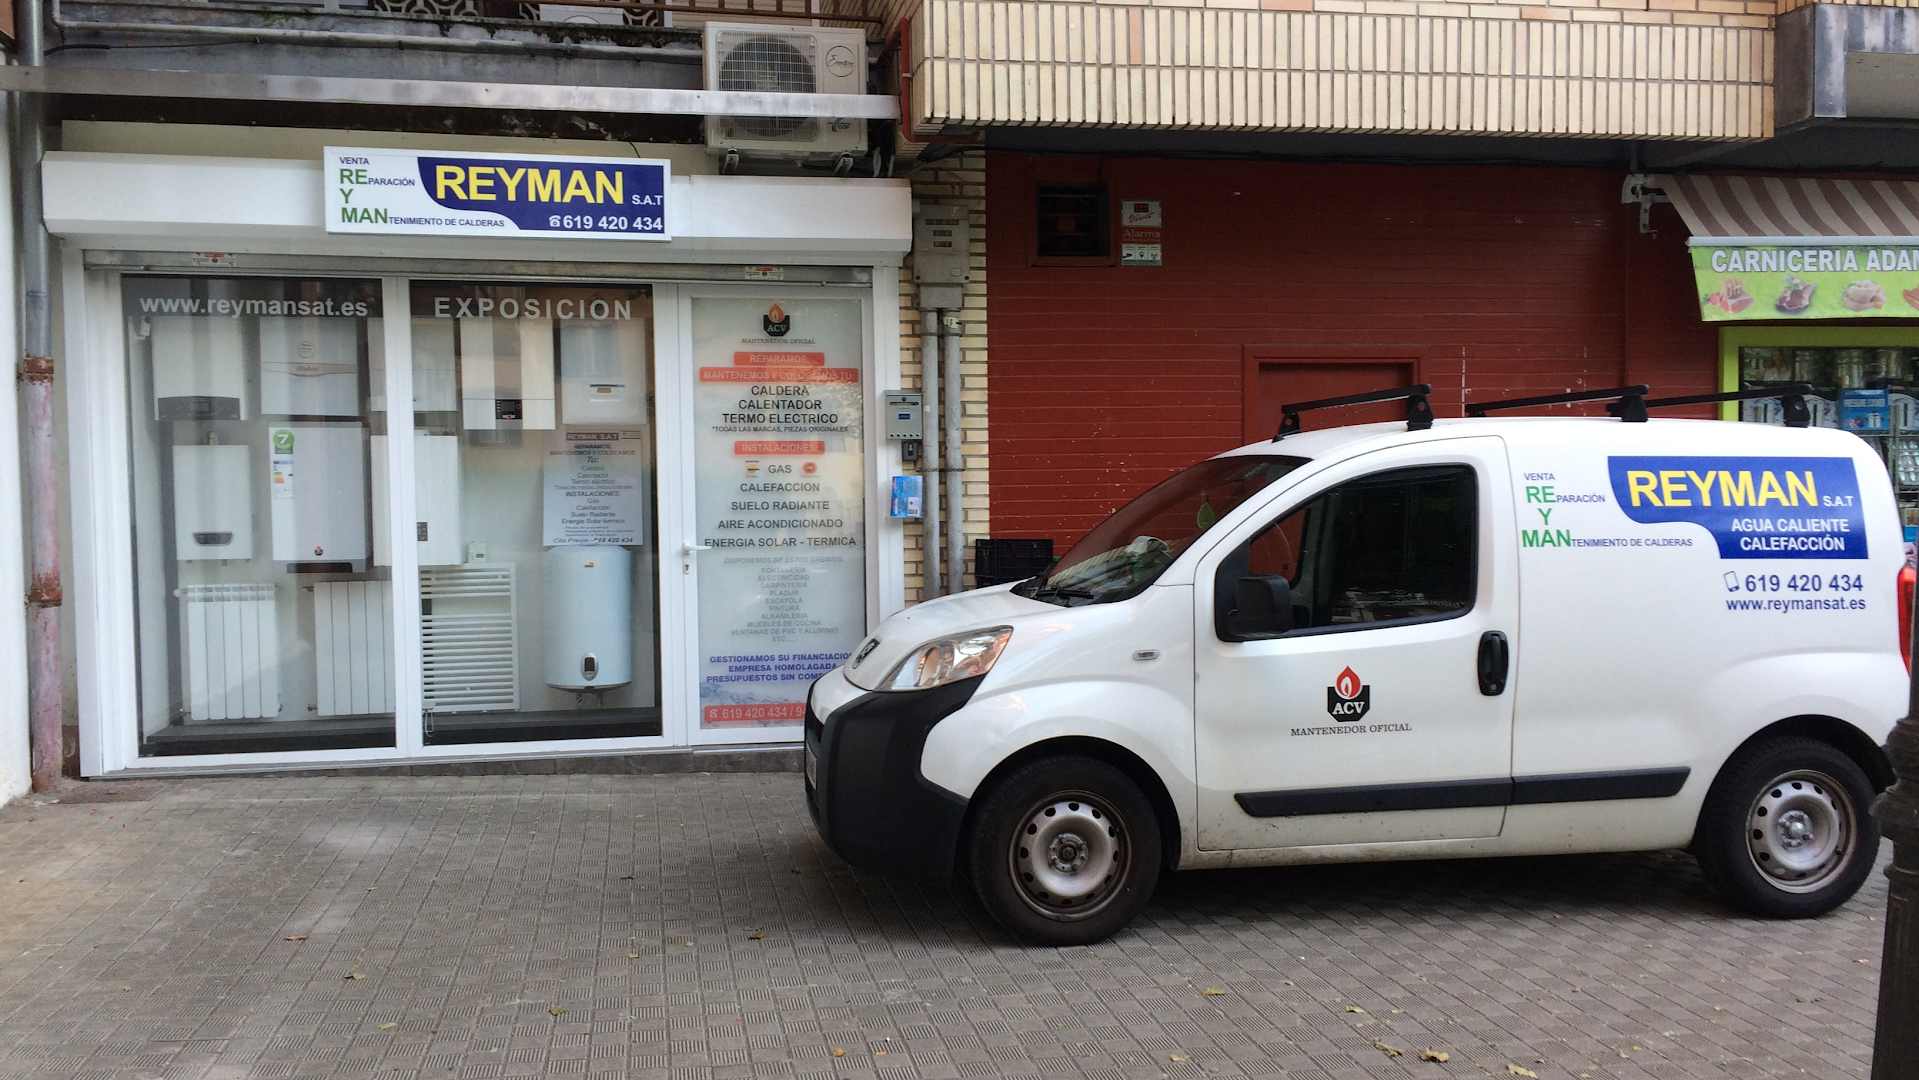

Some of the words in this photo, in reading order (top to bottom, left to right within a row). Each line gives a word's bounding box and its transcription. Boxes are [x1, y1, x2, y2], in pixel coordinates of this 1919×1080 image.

[339, 157, 370, 165] VENTA
[436, 165, 624, 204] REYMAN
[631, 194, 663, 206] S.A.T
[339, 188, 354, 204] Y
[445, 218, 457, 226] DE
[458, 218, 505, 228] CALDERAS
[563, 215, 594, 230] 619
[598, 216, 629, 231] 420
[632, 217, 663, 231] 434
[1124, 229, 1160, 237] Alarma
[1711, 250, 1859, 273] CARNICERIA
[139, 297, 368, 319] www.reymansat.es
[434, 297, 631, 321] EXPOSICION
[767, 324, 787, 332] ACV
[703, 371, 769, 379] MANTENEMOS
[778, 372, 838, 380] COLOCAMOS
[751, 385, 810, 396] CALDERA
[738, 399, 822, 410] CALENTADOR
[722, 413, 766, 424] TERMO
[769, 413, 838, 424] ELECTRICO
[277, 434, 289, 444] 7
[768, 464, 792, 473] GAS
[1524, 473, 1556, 481] VENTA
[740, 483, 820, 492] CALEFACCION
[1627, 470, 1818, 507] REYMAN
[1823, 495, 1853, 507] S.A.T
[731, 501, 770, 511] SUELO
[772, 501, 830, 510] RADIANTE
[1537, 508, 1553, 525] Y
[718, 520, 745, 529] AIRE
[747, 519, 843, 529] ACONDICIONADO
[1731, 518, 1774, 532] AGUA
[1777, 518, 1850, 532] CALIENTE
[704, 538, 756, 547] ENERGIA
[758, 538, 797, 547] SOLAR
[806, 537, 857, 546] TERMICA
[1630, 539, 1643, 547] DE
[1644, 538, 1693, 547] CALDERAS
[1740, 534, 1845, 551] CALEFACCIÓN
[1745, 574, 1780, 592] 619
[1787, 574, 1822, 592] 420
[1829, 574, 1864, 592] 434
[1726, 597, 1866, 613] www.reymansat.es
[710, 655, 775, 663] GESTIONAMOS
[778, 654, 790, 662] SU
[729, 664, 772, 672] EMPRESA
[774, 663, 837, 671] HOMOLAGADA
[706, 674, 778, 683] PRESUPUESTOS
[722, 709, 743, 719] 619
[745, 708, 765, 718] 420
[768, 707, 787, 717] 434
[1332, 701, 1365, 715] ACV
[1290, 725, 1367, 737] MANTENEDOR
[1369, 723, 1412, 733] OFICIAL
